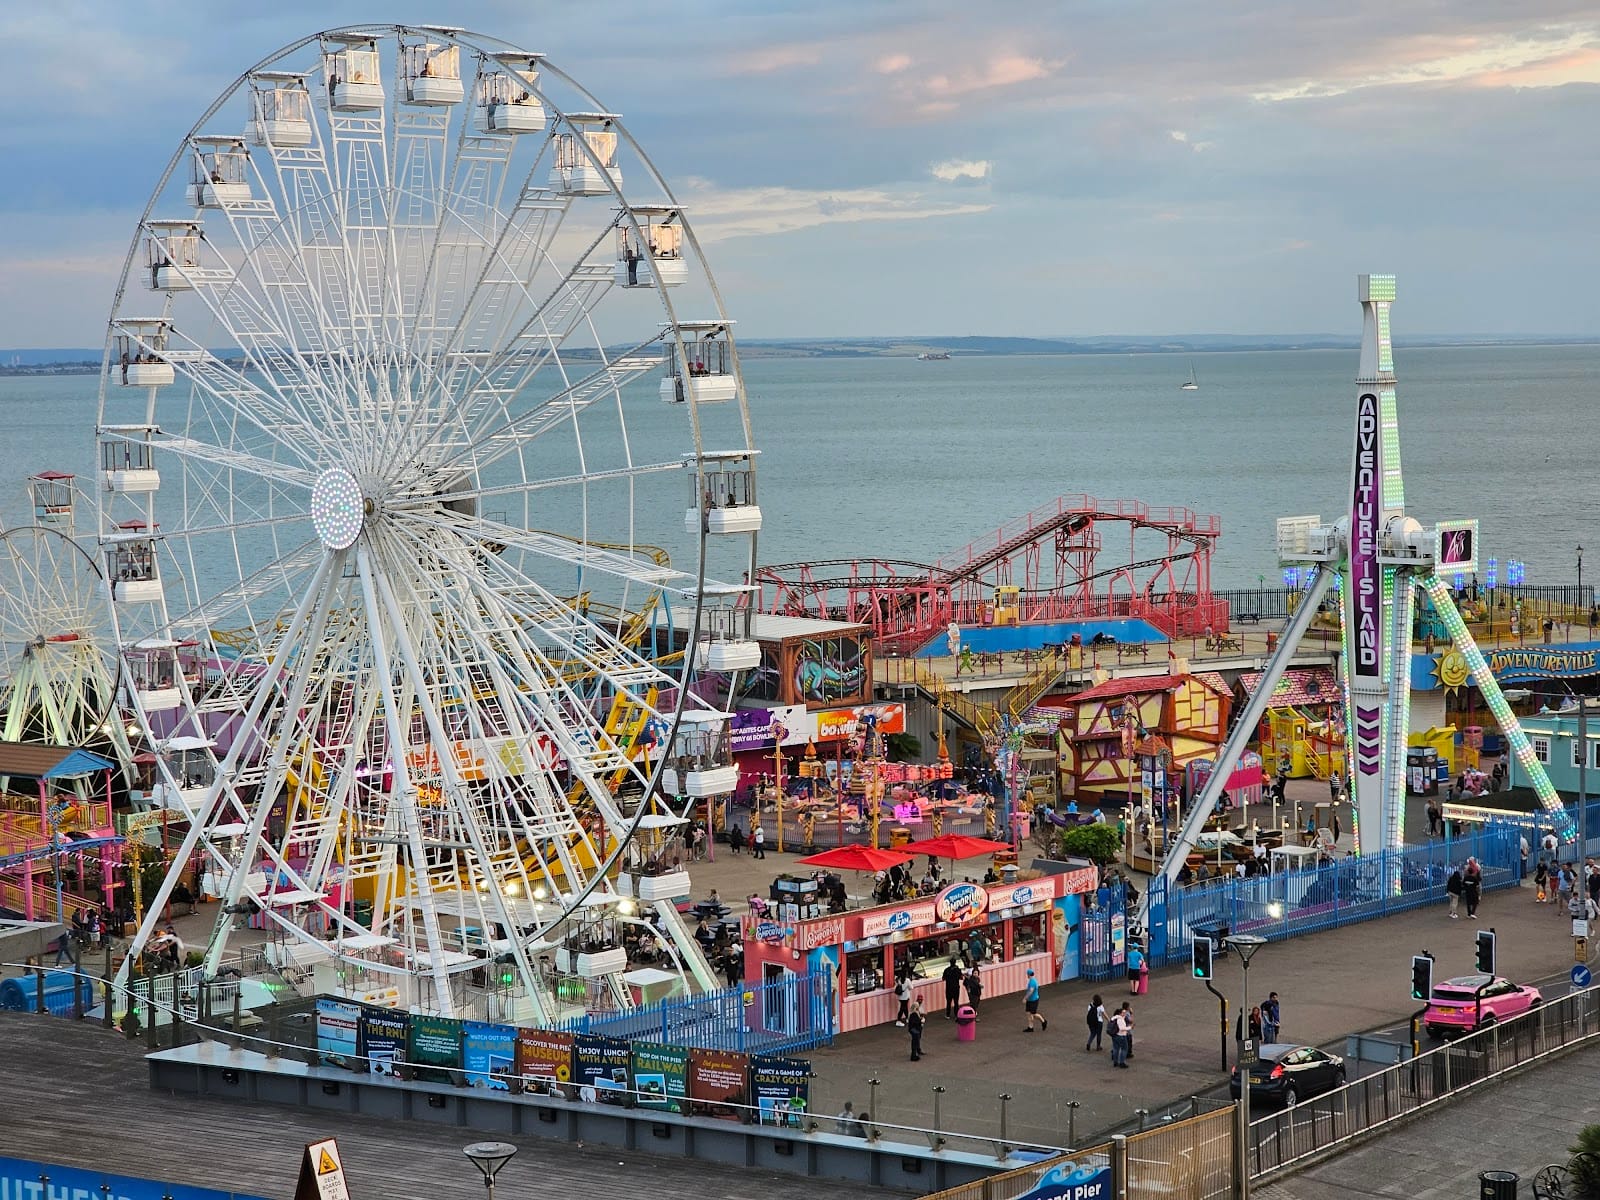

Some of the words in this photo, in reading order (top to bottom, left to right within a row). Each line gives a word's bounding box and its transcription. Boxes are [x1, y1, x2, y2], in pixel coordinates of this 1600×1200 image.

[1359, 398, 1374, 555] ADVENTURE
[1360, 561, 1375, 665] ISLAND
[1490, 652, 1596, 673] ADVENTUREVILLE
[366, 1024, 384, 1036] THE
[382, 1020, 403, 1028] SUPPORT
[548, 1042, 559, 1050] THE
[523, 1046, 571, 1062] MUSEUM
[604, 1049, 627, 1057] LUNCH
[579, 1055, 600, 1063] WITH
[609, 1056, 628, 1064] VIEW
[636, 1057, 685, 1074] RAILWAY
[754, 1075, 780, 1083] CRAZY
[783, 1076, 807, 1084] GOLF?
[323, 1181, 341, 1190] BOARDS
[1075, 1183, 1102, 1200] Pier
